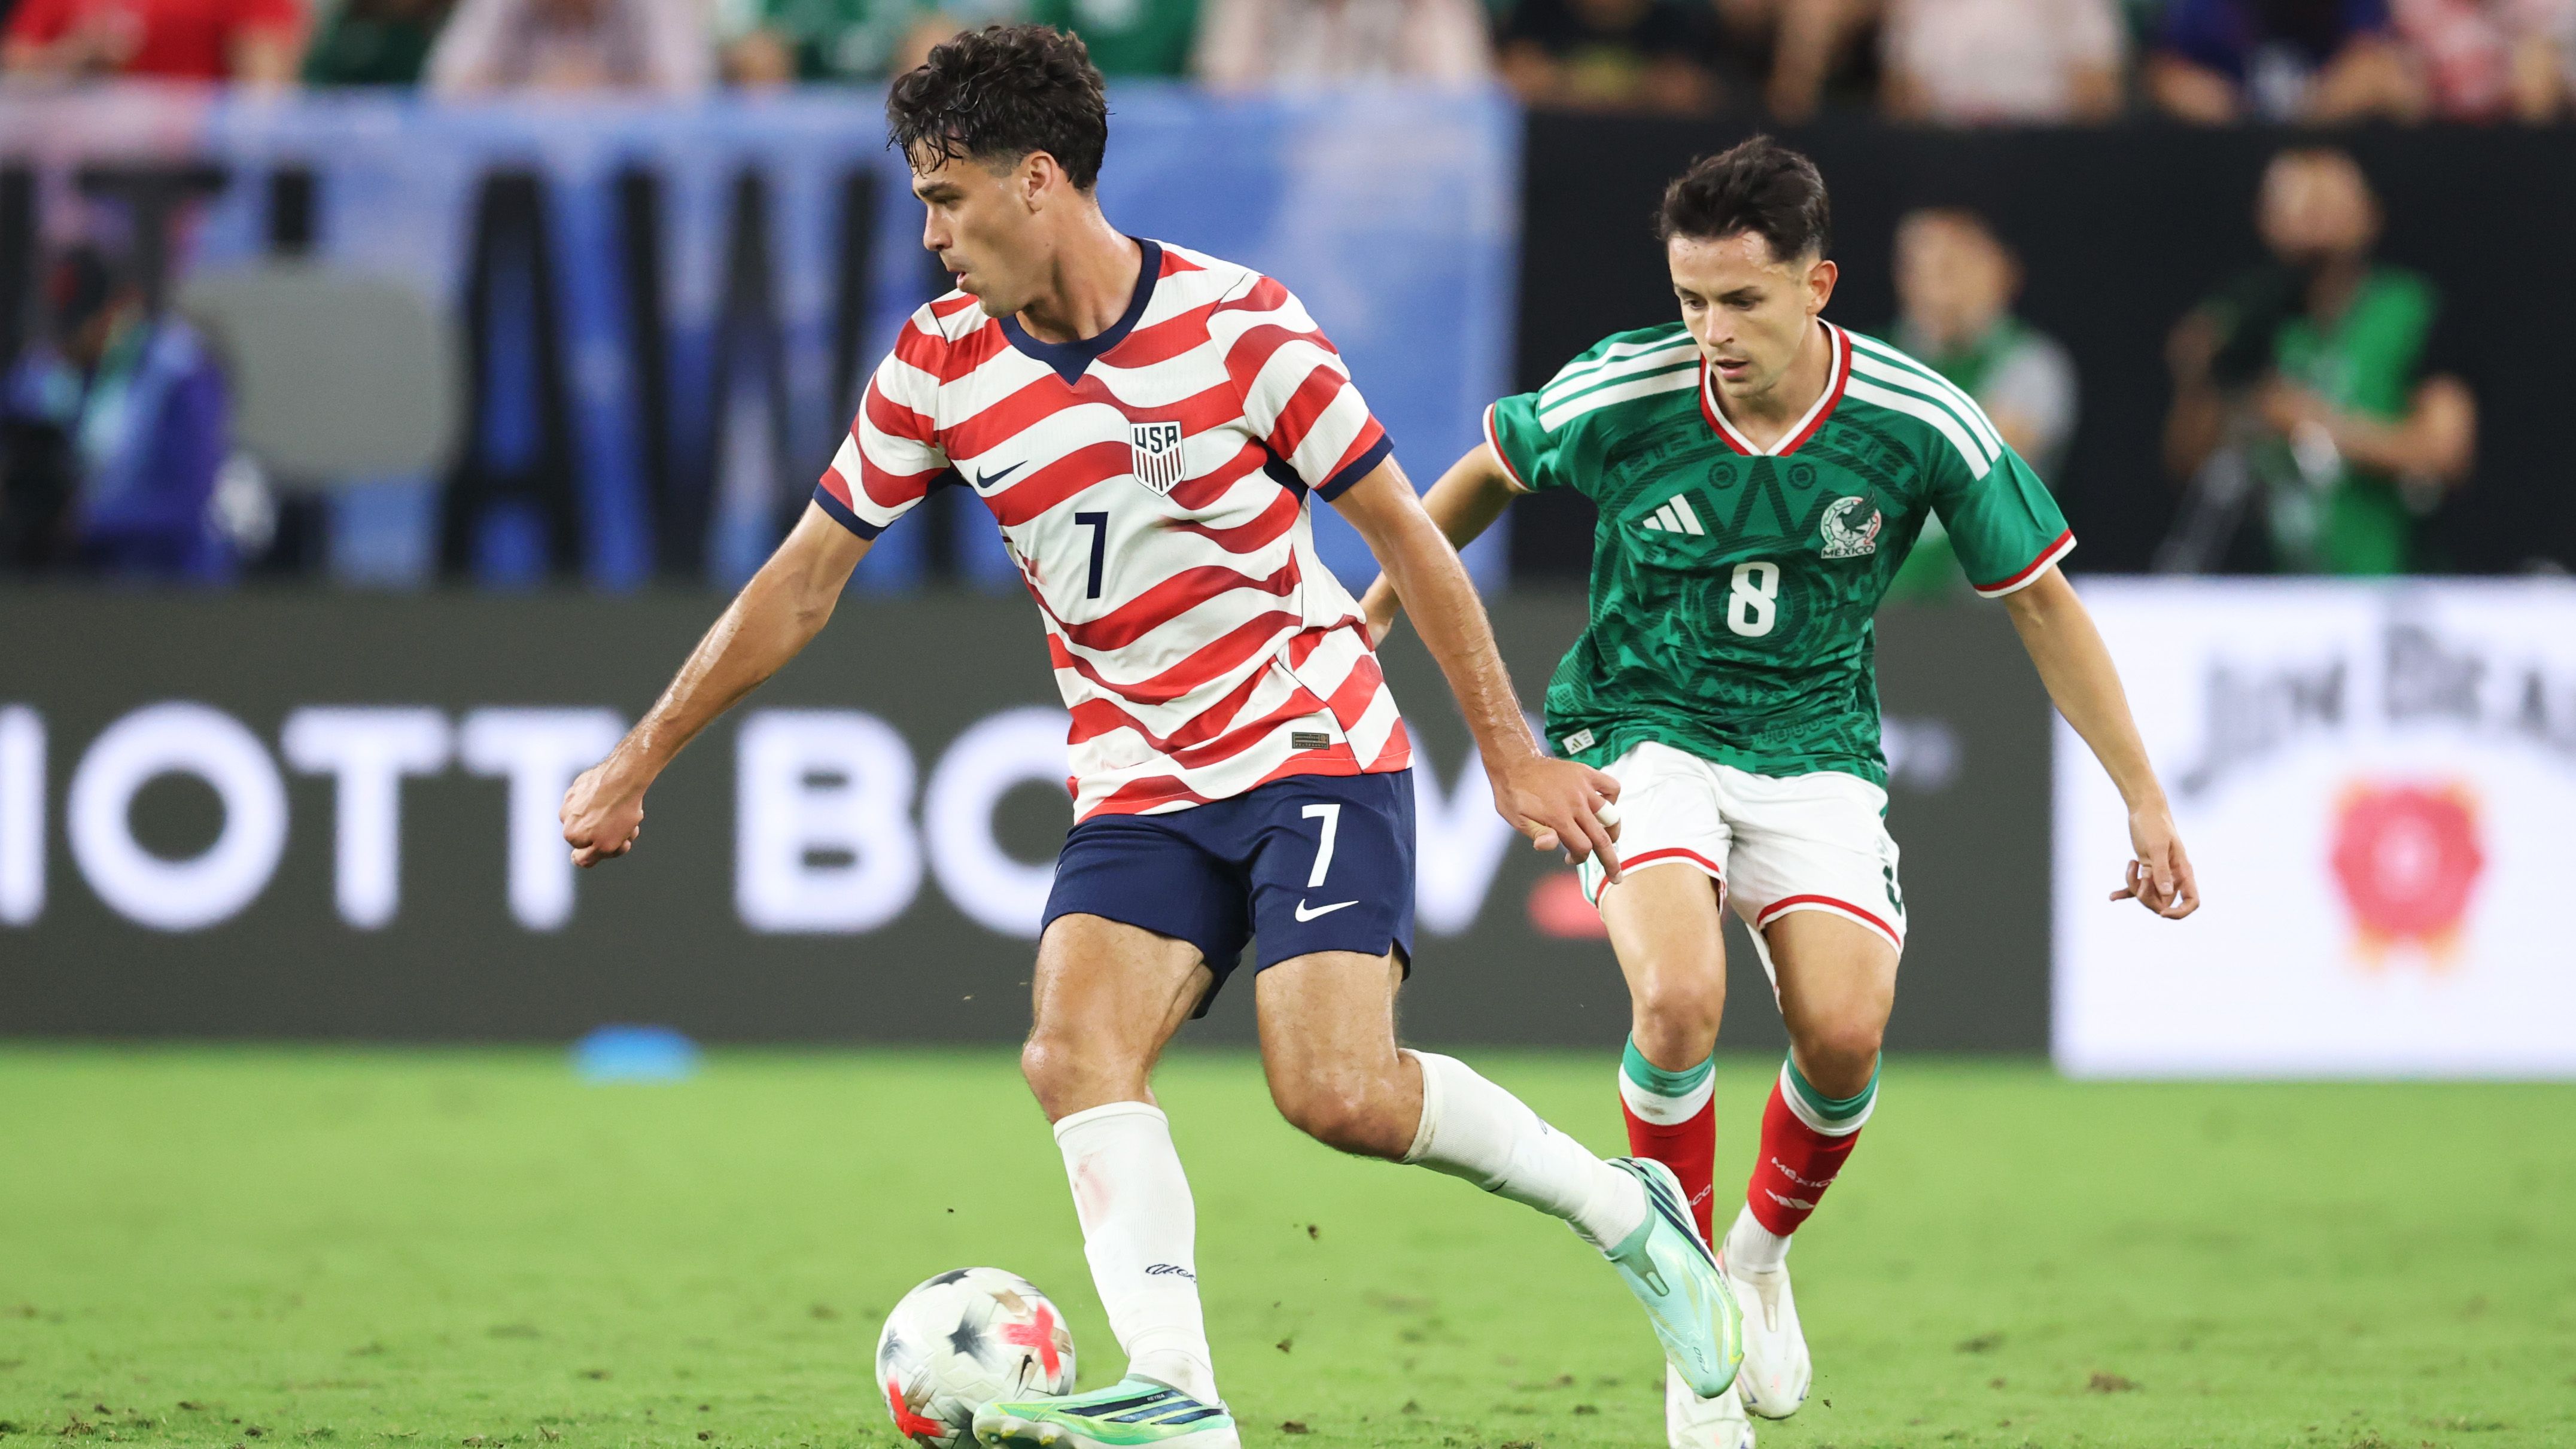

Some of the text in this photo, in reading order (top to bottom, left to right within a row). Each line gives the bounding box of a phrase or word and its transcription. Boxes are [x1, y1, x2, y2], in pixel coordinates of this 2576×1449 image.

[1134, 426, 1178, 453] USA
[1075, 512, 1109, 599] 7
[1727, 561, 1780, 637] 8
[1301, 803, 1341, 888] 7
